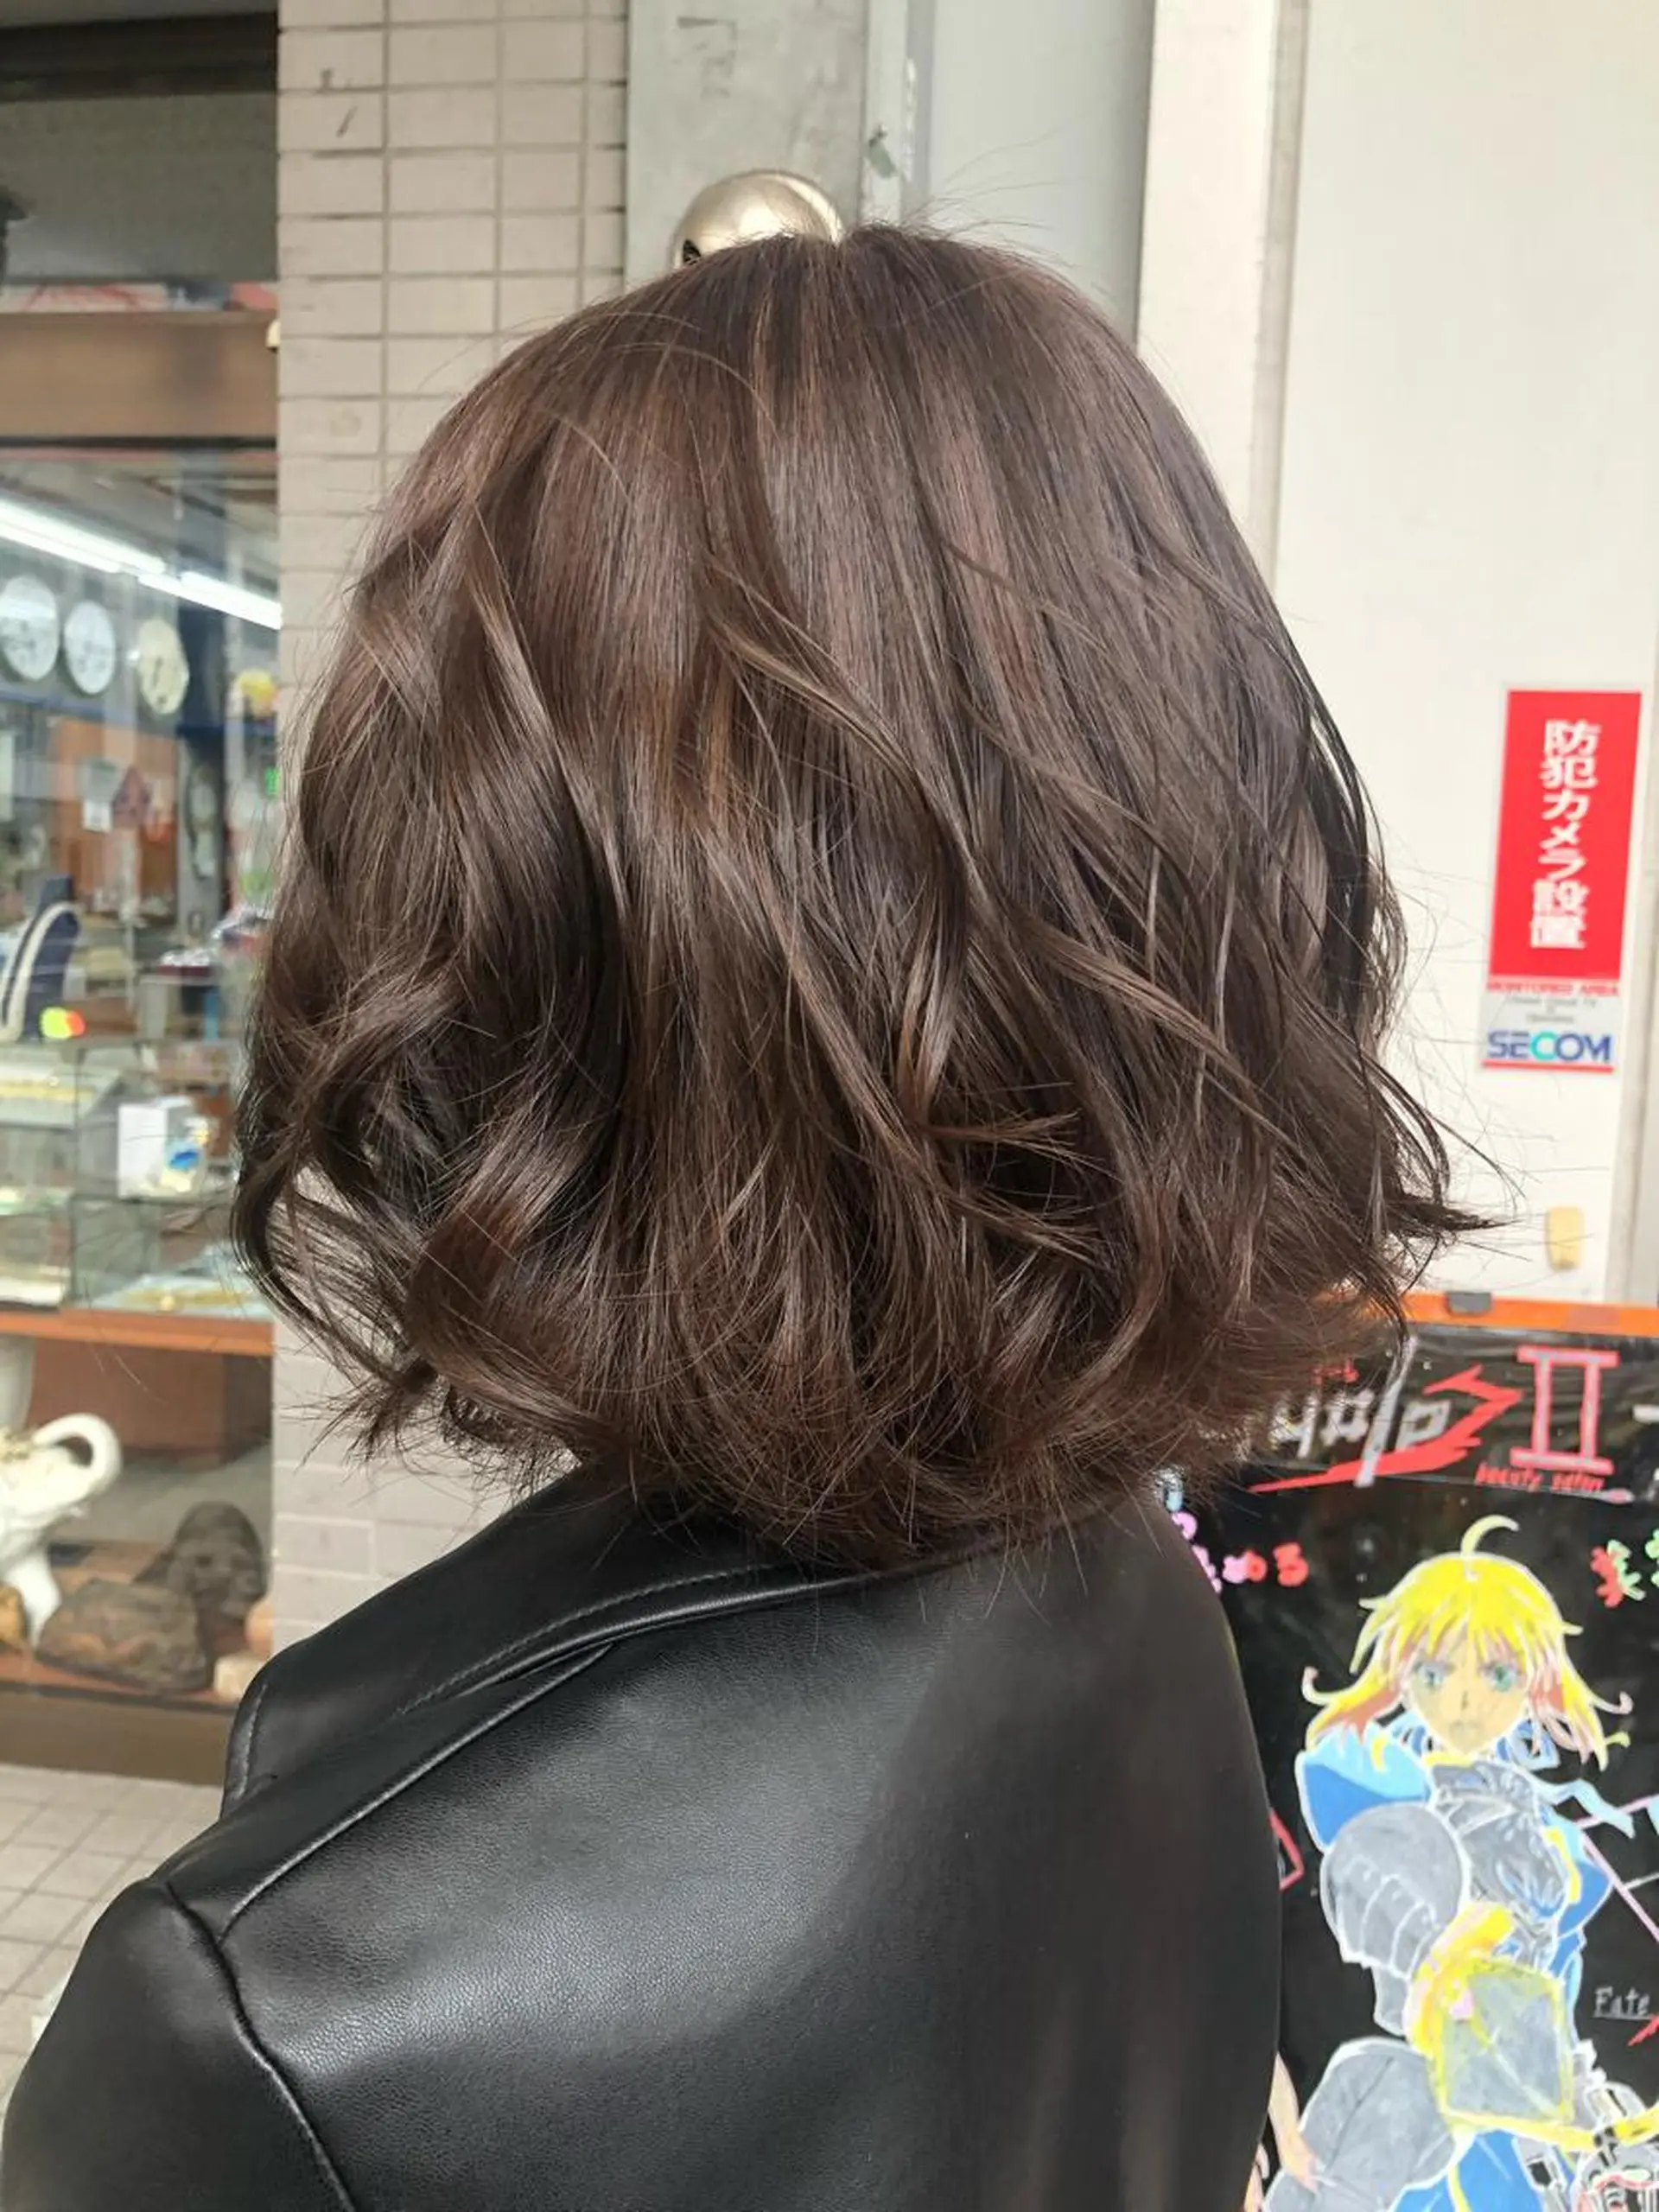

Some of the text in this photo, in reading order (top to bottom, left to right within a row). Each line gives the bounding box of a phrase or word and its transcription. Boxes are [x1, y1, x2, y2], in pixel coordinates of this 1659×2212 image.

[1529, 719, 1601, 949] 防犯カメラ設置
[1488, 1030, 1612, 1061] SECOM
